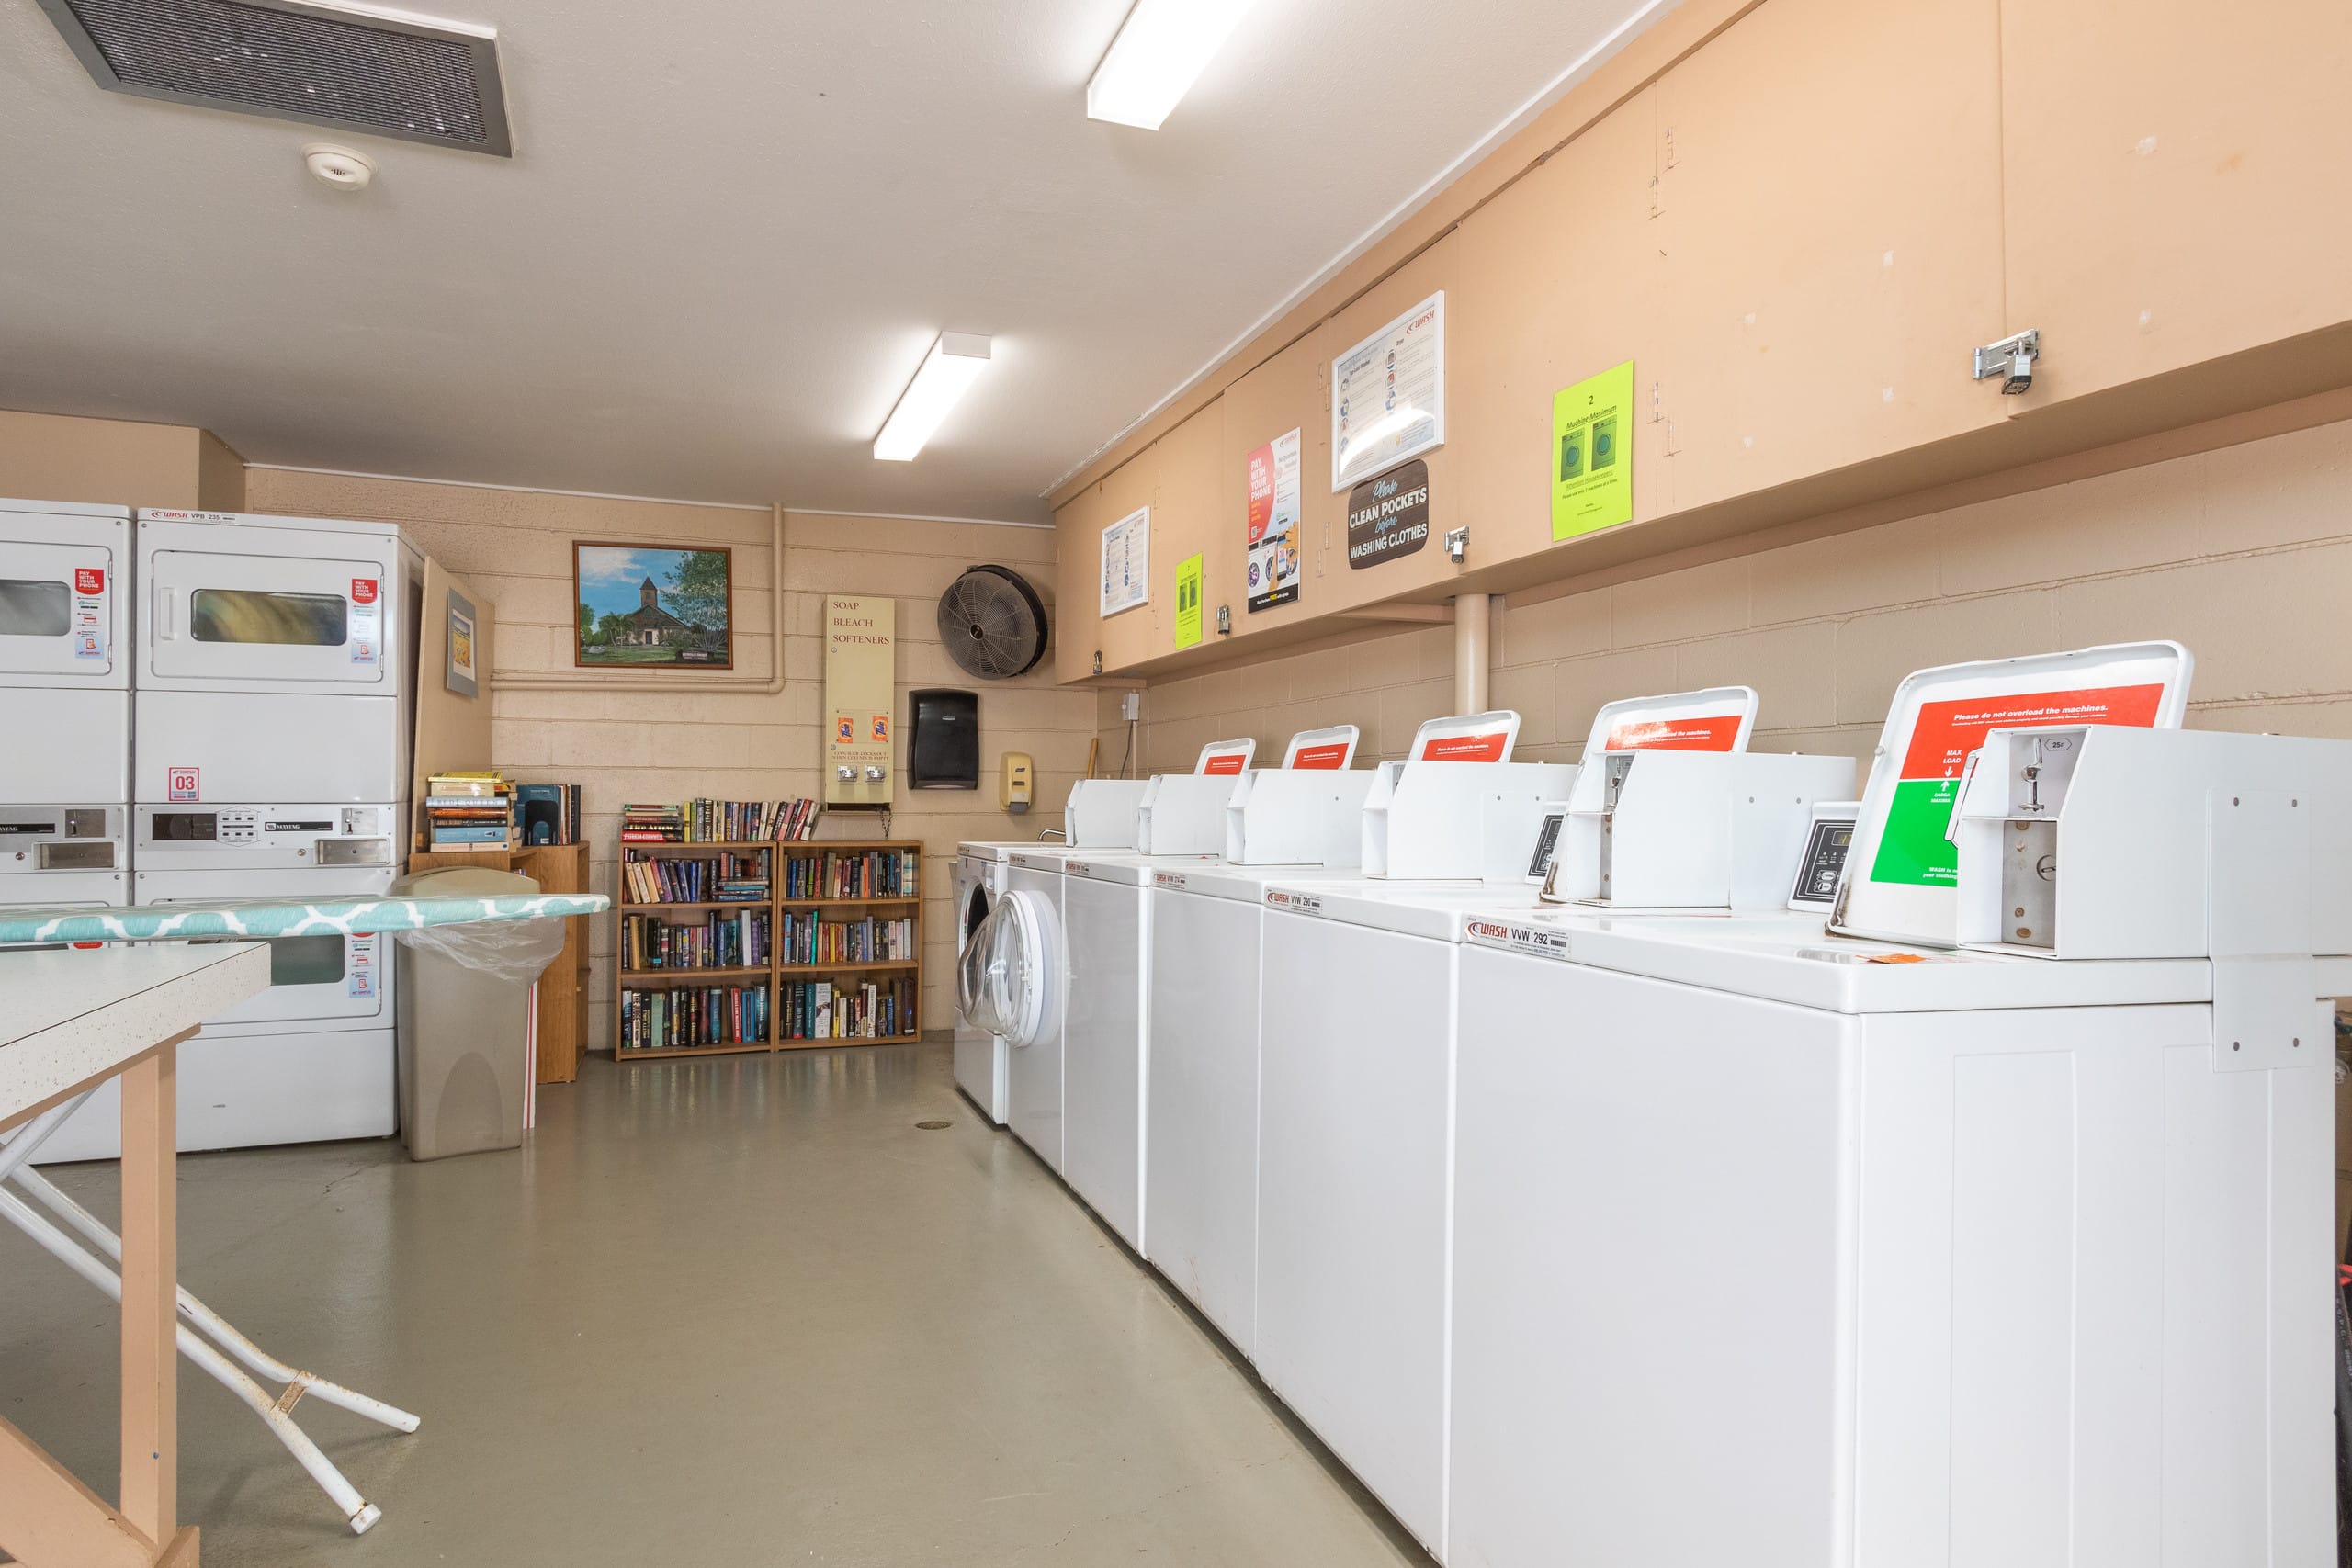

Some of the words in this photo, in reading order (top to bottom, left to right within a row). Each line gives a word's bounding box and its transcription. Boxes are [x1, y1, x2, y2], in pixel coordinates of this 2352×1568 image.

[1415, 310, 1434, 328] WASH
[1589, 395, 1594, 405] 2
[1566, 417, 1589, 430] Machine
[1589, 405, 1617, 420] Maximum
[1251, 457, 1262, 470] PAY
[1251, 466, 1266, 481] WITH
[1251, 476, 1267, 491] YOUR
[1372, 479, 1398, 502] Please
[1251, 484, 1272, 502] PHONE
[1350, 505, 1379, 528] CLEAN
[1381, 487, 1427, 516] POCKETS
[1375, 515, 1398, 534] before
[1350, 536, 1388, 559] WASHING
[1388, 523, 1428, 547] CLOTHES
[833, 601, 860, 610] SOAP
[833, 617, 874, 627] BLEACH
[832, 634, 890, 645] SOFTENERS
[2007, 708, 2044, 717] overload
[2045, 706, 2061, 715] the
[2062, 705, 2109, 714] machines.
[175, 775, 195, 791] 03
[1274, 893, 1289, 903] WASH
[1291, 895, 1302, 905] VVW
[1480, 923, 1508, 939] WASH
[1511, 928, 1531, 942] VVW
[1533, 931, 1548, 945] 292
